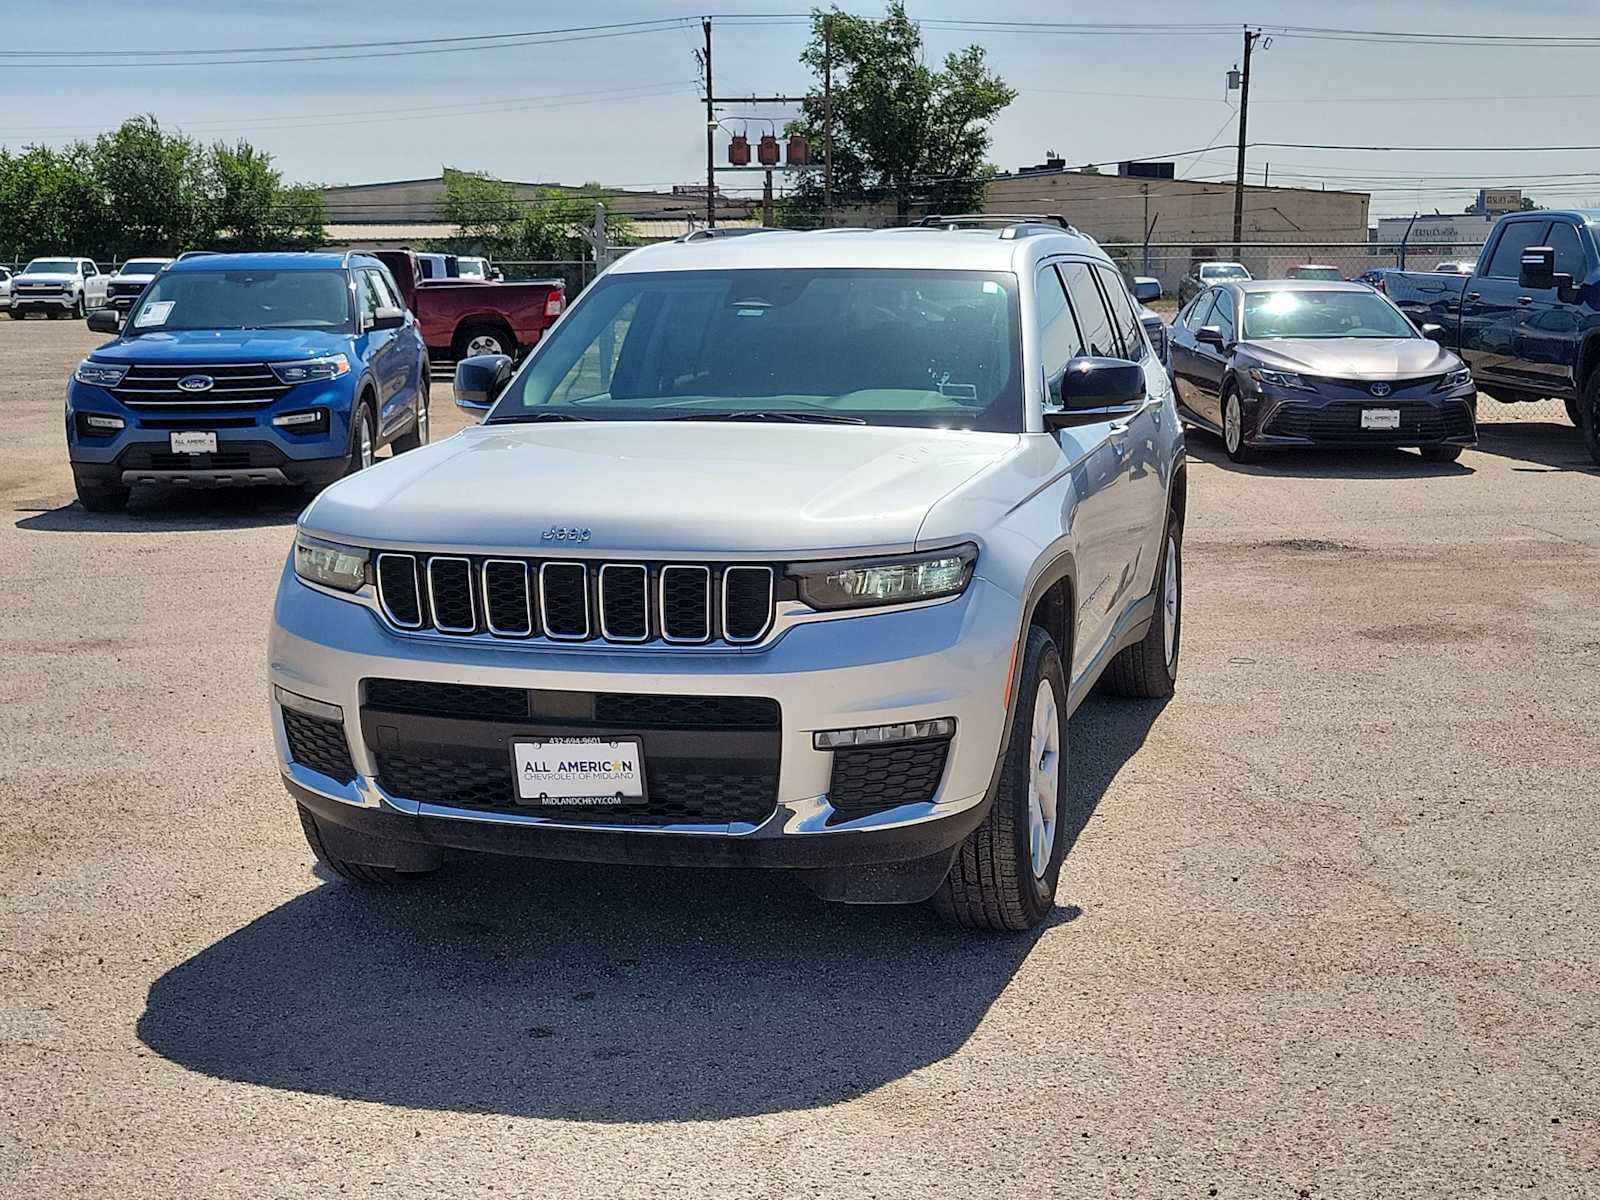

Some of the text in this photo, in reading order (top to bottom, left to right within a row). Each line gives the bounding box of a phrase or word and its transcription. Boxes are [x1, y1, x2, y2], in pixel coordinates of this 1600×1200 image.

[542, 527, 592, 543] Jeep
[524, 761, 551, 772] ALL
[541, 797, 621, 805] MIDLANDCHEVY.COM
